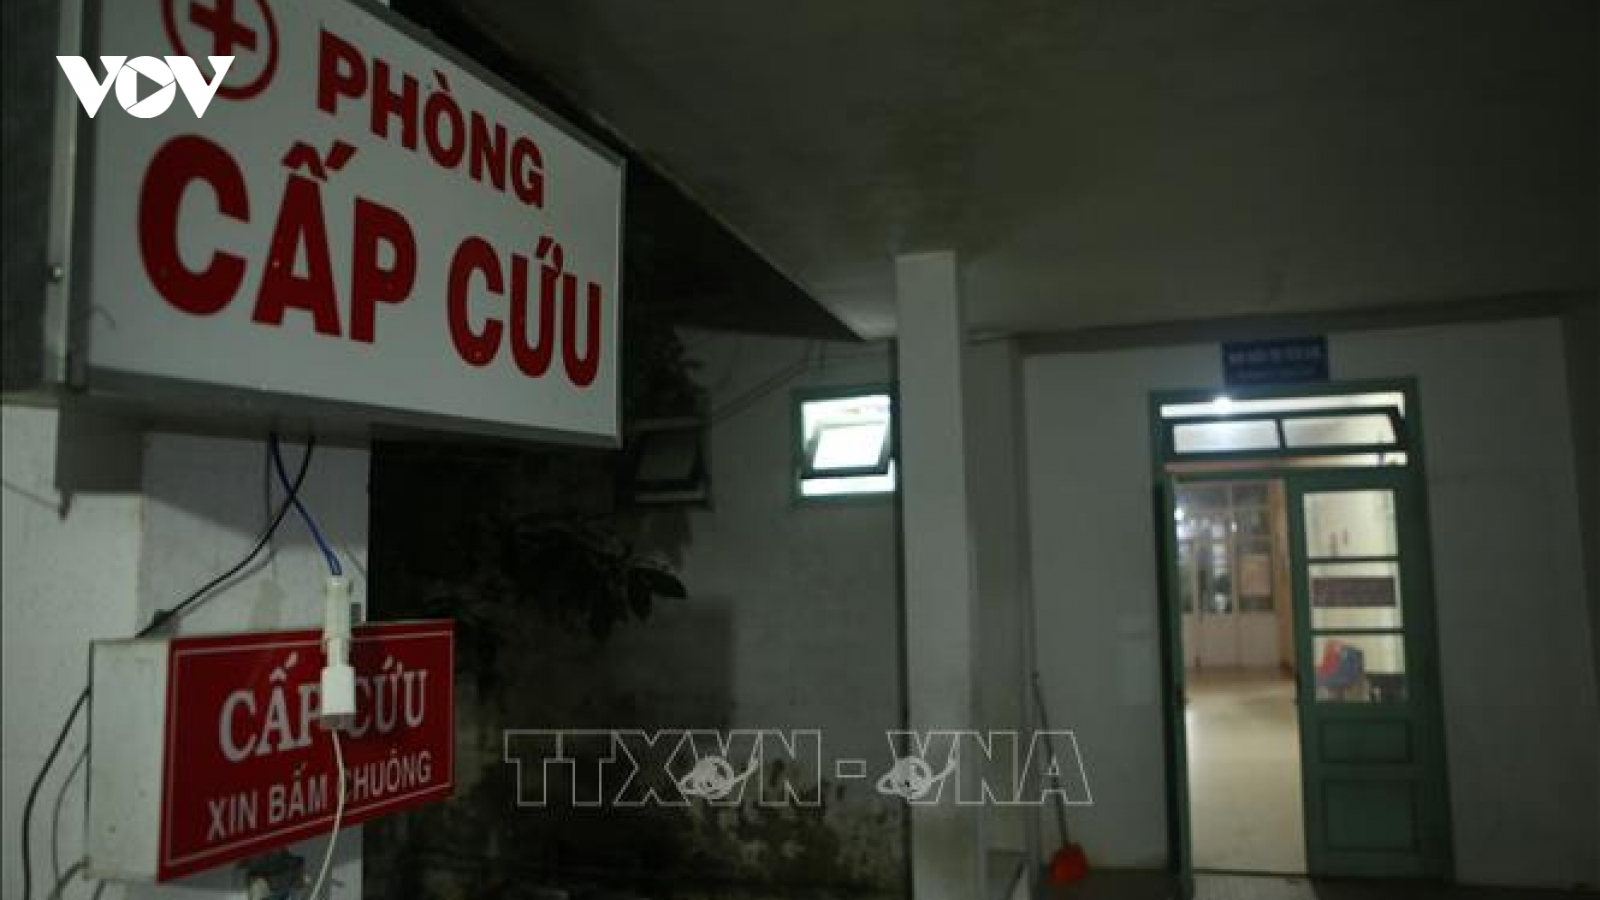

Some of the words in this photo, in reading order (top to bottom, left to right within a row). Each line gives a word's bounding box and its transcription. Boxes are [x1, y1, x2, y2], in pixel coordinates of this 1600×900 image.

[317, 29, 545, 209] PHÒNG
[138, 134, 417, 343] CẤP
[447, 236, 601, 387] CỨU
[206, 789, 258, 841] XIN
[269, 763, 327, 824] BẤM
